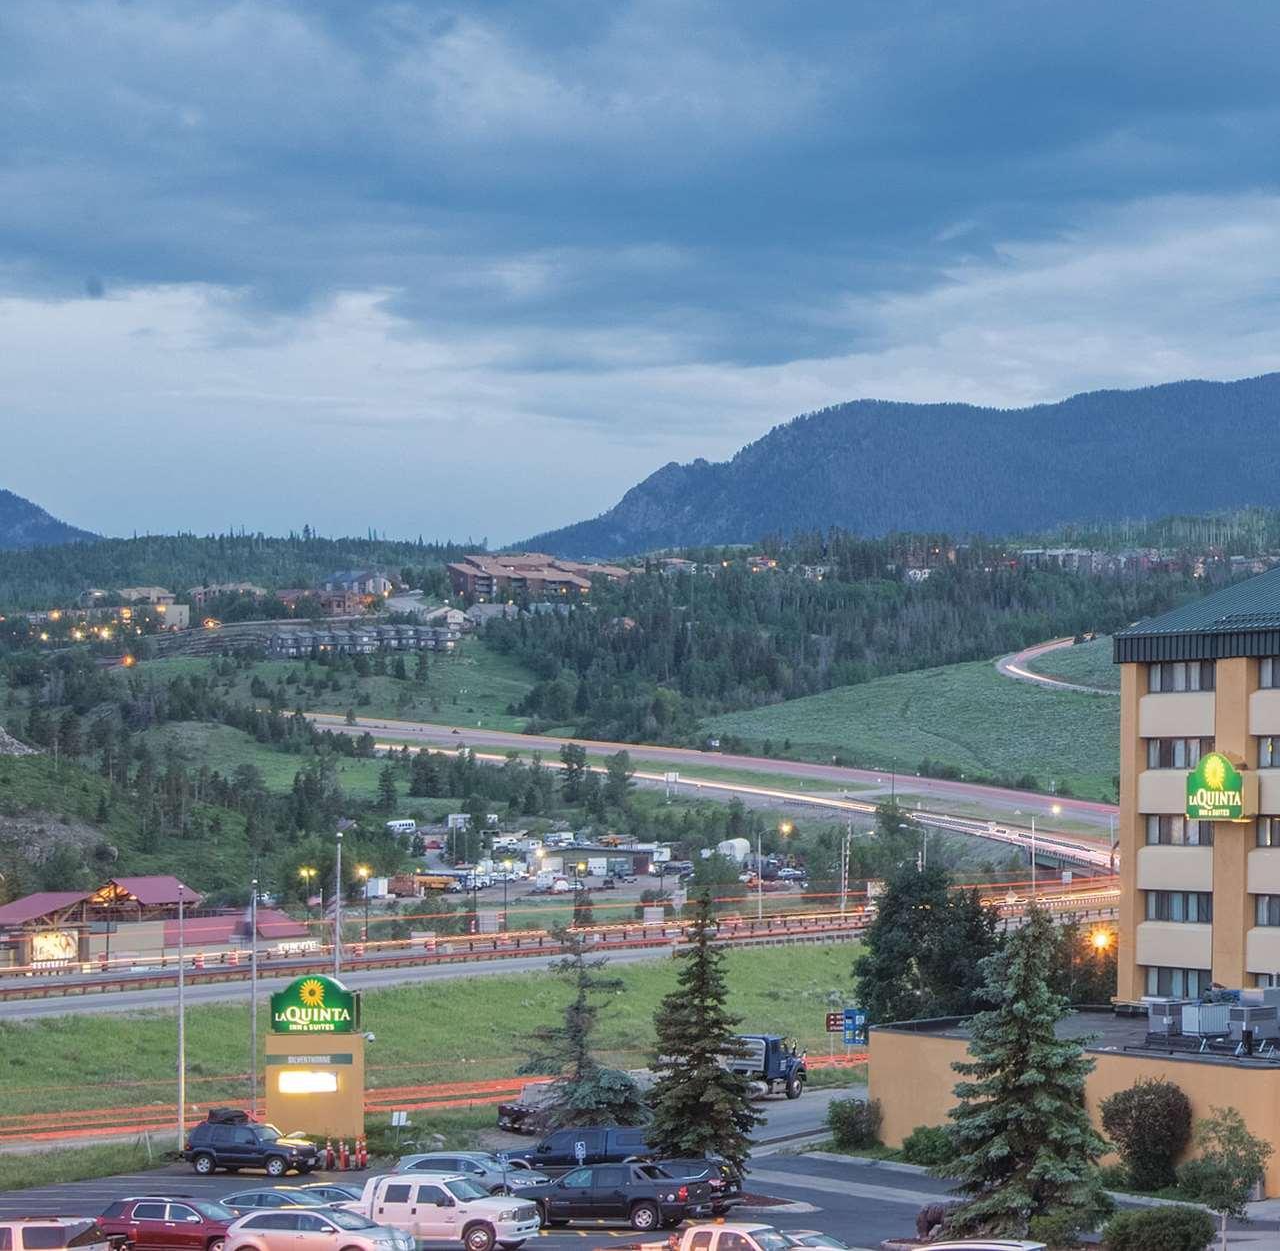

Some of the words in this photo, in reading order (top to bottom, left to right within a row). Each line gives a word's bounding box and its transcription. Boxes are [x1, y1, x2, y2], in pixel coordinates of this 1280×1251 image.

[1189, 795, 1197, 805] LA
[1197, 788, 1241, 809] QUINTA
[275, 1013, 286, 1021] LA
[286, 1006, 351, 1025] QUINTA
[309, 1023, 335, 1031] SUITES
